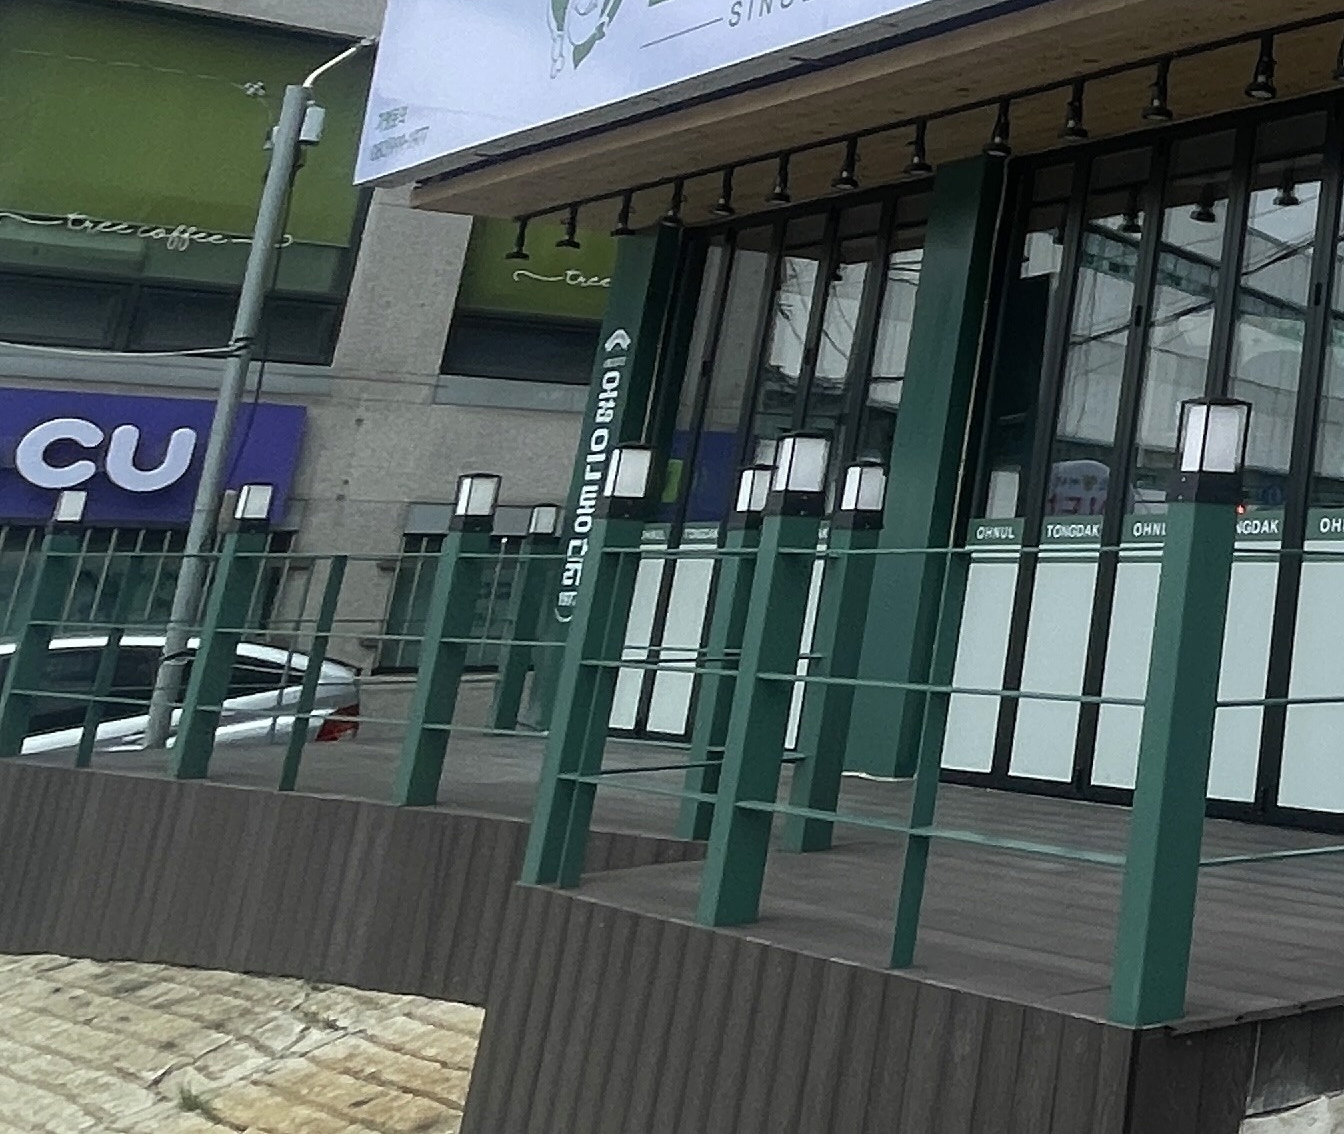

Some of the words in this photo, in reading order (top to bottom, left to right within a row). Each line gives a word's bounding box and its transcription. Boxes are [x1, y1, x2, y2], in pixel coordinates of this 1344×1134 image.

[16, 418, 197, 492] CU
[976, 526, 1016, 540] OHNUL
[1046, 524, 1101, 539] TONGDAK
